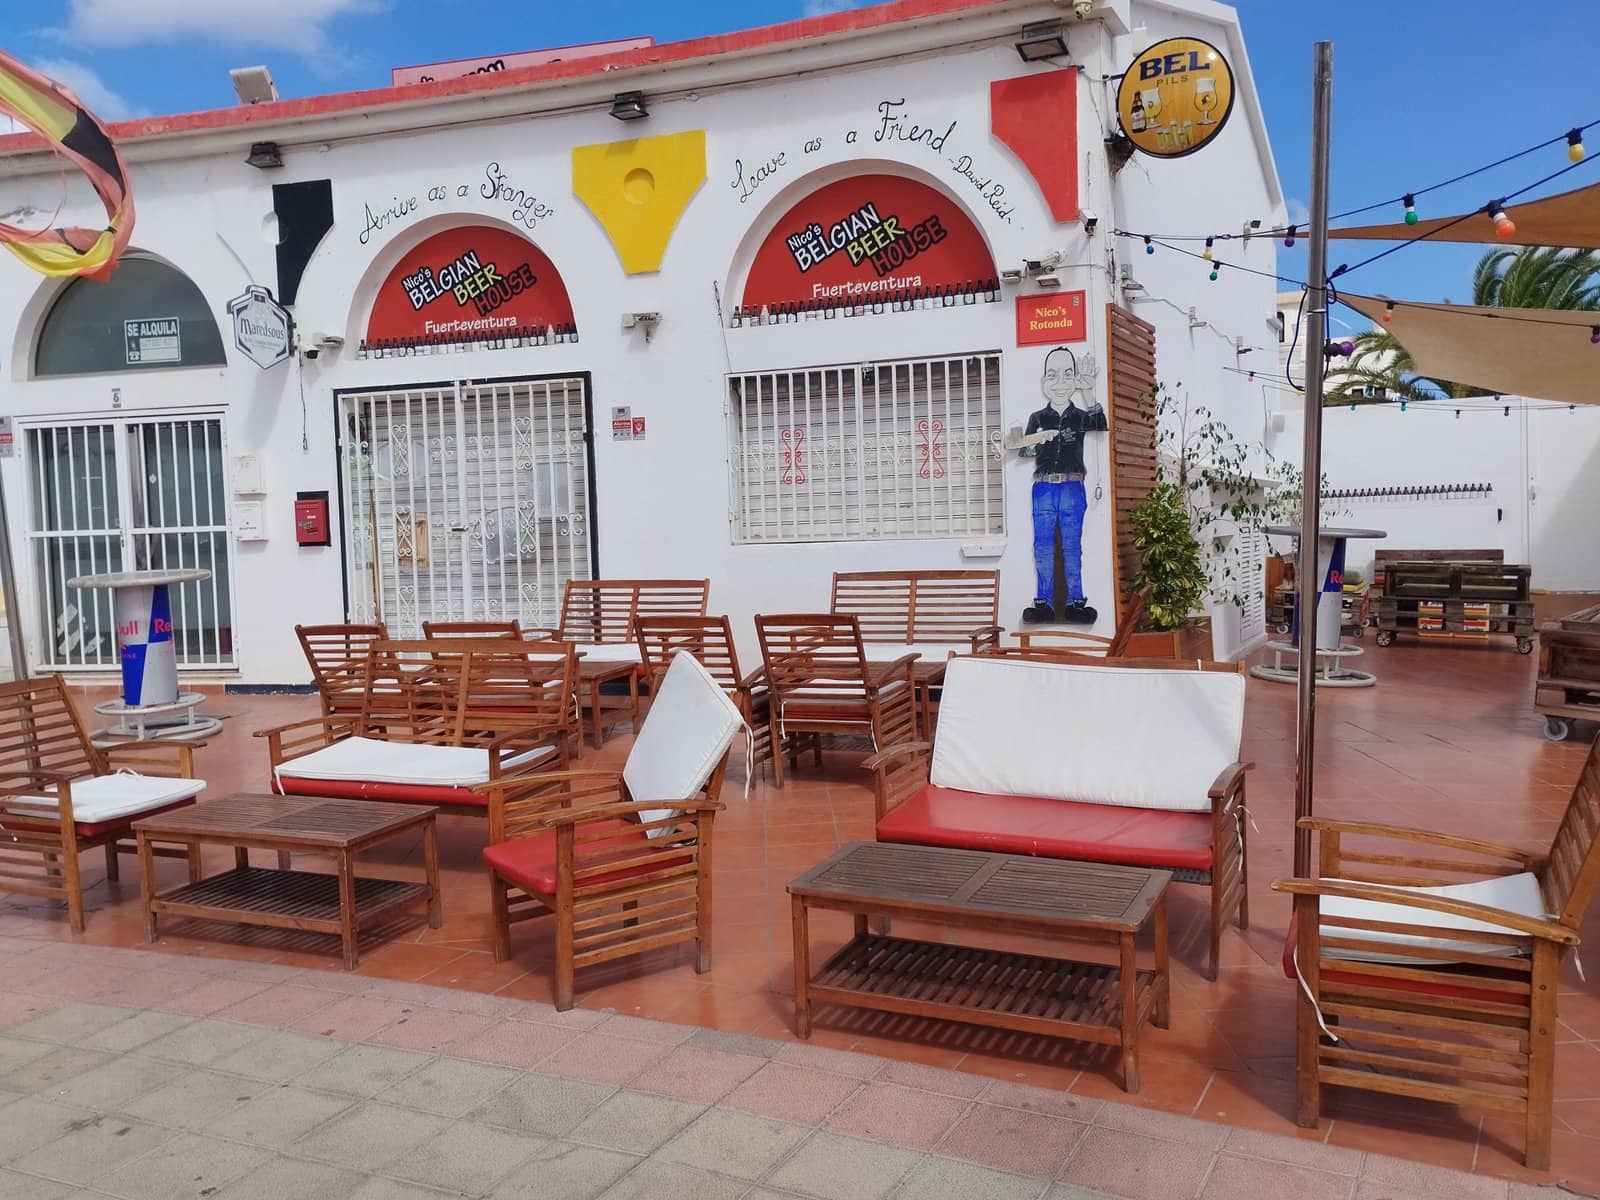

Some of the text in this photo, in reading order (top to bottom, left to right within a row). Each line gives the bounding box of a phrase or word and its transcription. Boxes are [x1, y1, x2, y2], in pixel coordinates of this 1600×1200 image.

[1139, 51, 1210, 81] BEL
[1156, 75, 1189, 87] PILS
[731, 98, 957, 204] Leave as a Friend
[359, 162, 554, 244] Arrive as a Stranger
[787, 224, 822, 251] Nico's
[794, 204, 881, 271] BELGIAN
[847, 217, 905, 264] BEER
[870, 217, 947, 276] HOUSE
[403, 267, 432, 291] Nico's
[409, 251, 481, 309] BELGIAN
[453, 263, 502, 305] BEER
[474, 265, 536, 315] HOUSE
[812, 275, 922, 298] Fuerteventura
[424, 315, 517, 334] Fuerteventura
[1029, 318, 1073, 331] Rotonda
[1035, 305, 1067, 318] Nico's
[127, 321, 177, 336] SE ALQUILA
[240, 317, 285, 339] Maredsous
[154, 618, 172, 634] Re
